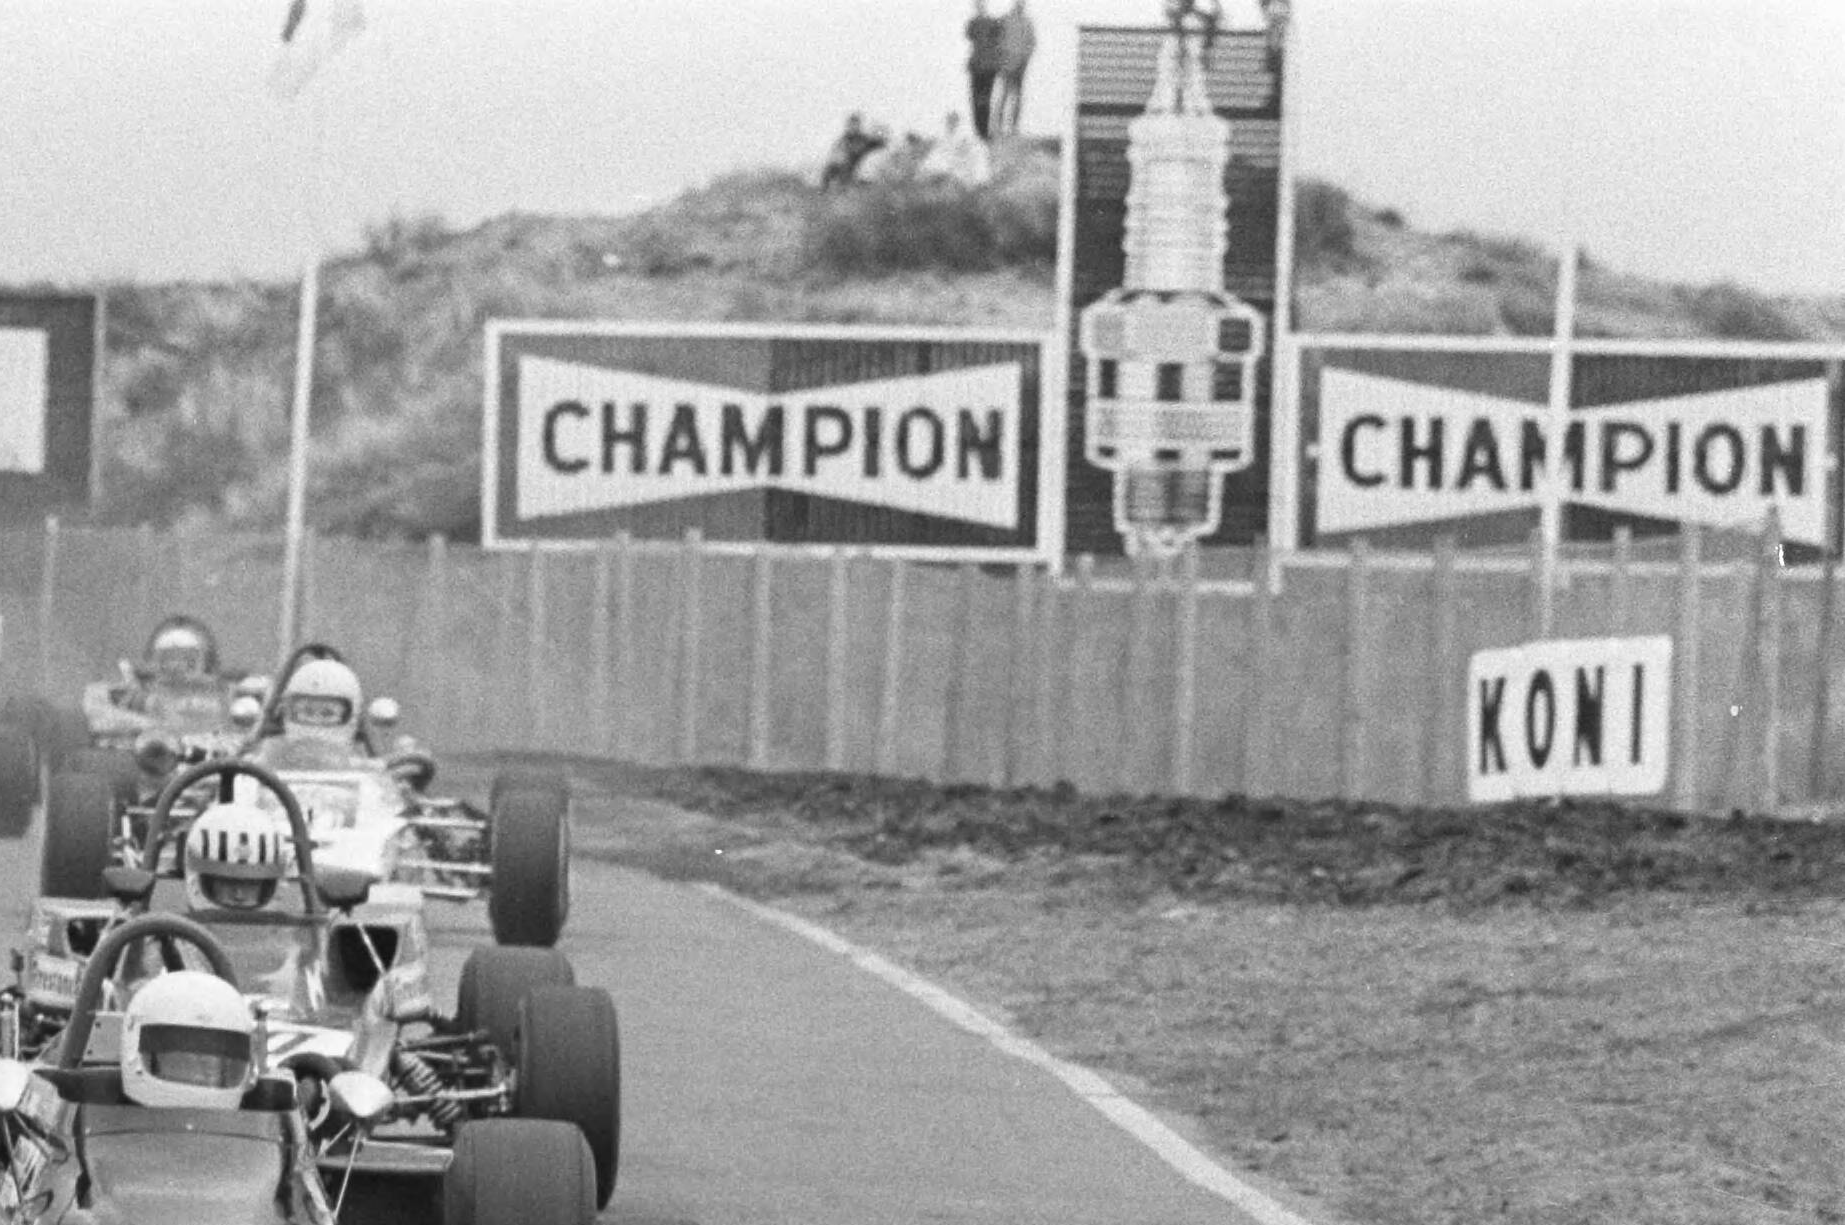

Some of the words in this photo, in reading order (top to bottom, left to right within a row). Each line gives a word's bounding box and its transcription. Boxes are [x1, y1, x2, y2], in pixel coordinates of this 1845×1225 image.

[542, 402, 1003, 480] CHAMPION
[1340, 414, 1805, 496] CHAMPION
[1479, 663, 1643, 775] KONI
